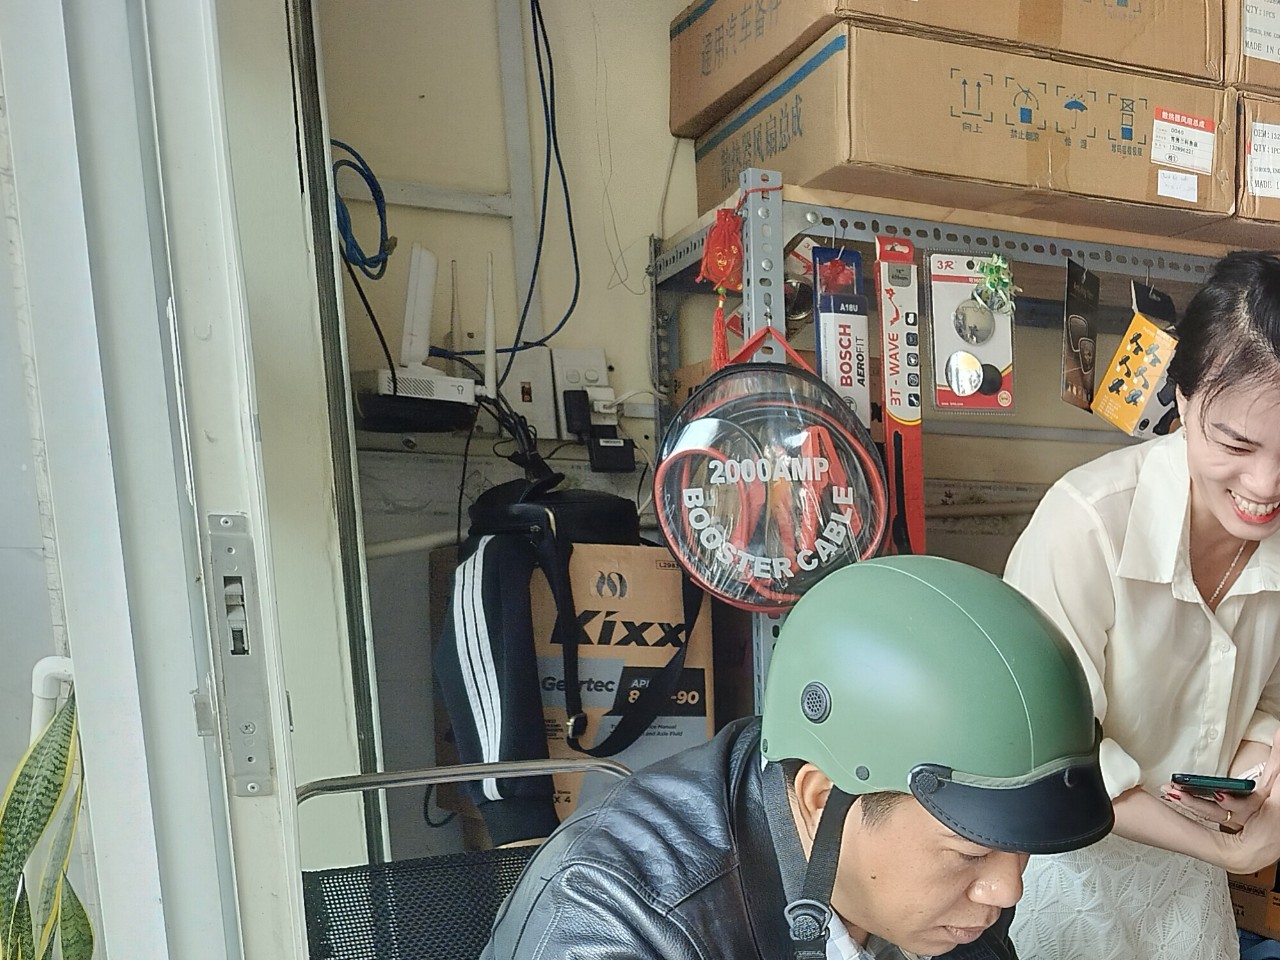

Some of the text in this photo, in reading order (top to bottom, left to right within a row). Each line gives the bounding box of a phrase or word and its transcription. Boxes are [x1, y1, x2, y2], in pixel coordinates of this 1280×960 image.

[1244, 40, 1262, 52] MADE
[1266, 44, 1274, 55] IN
[962, 121, 983, 134] 向上
[1254, 179, 1273, 190] MADE
[839, 302, 859, 313] A18U
[838, 323, 853, 388] BOSCH
[855, 336, 867, 388] AEROFIT
[888, 332, 900, 377] WAVE
[708, 457, 829, 484] 2000AMP
[682, 485, 854, 579] BOOSTER CABLE
[550, 610, 686, 648] Kixx
[541, 675, 616, 693] Gertec
